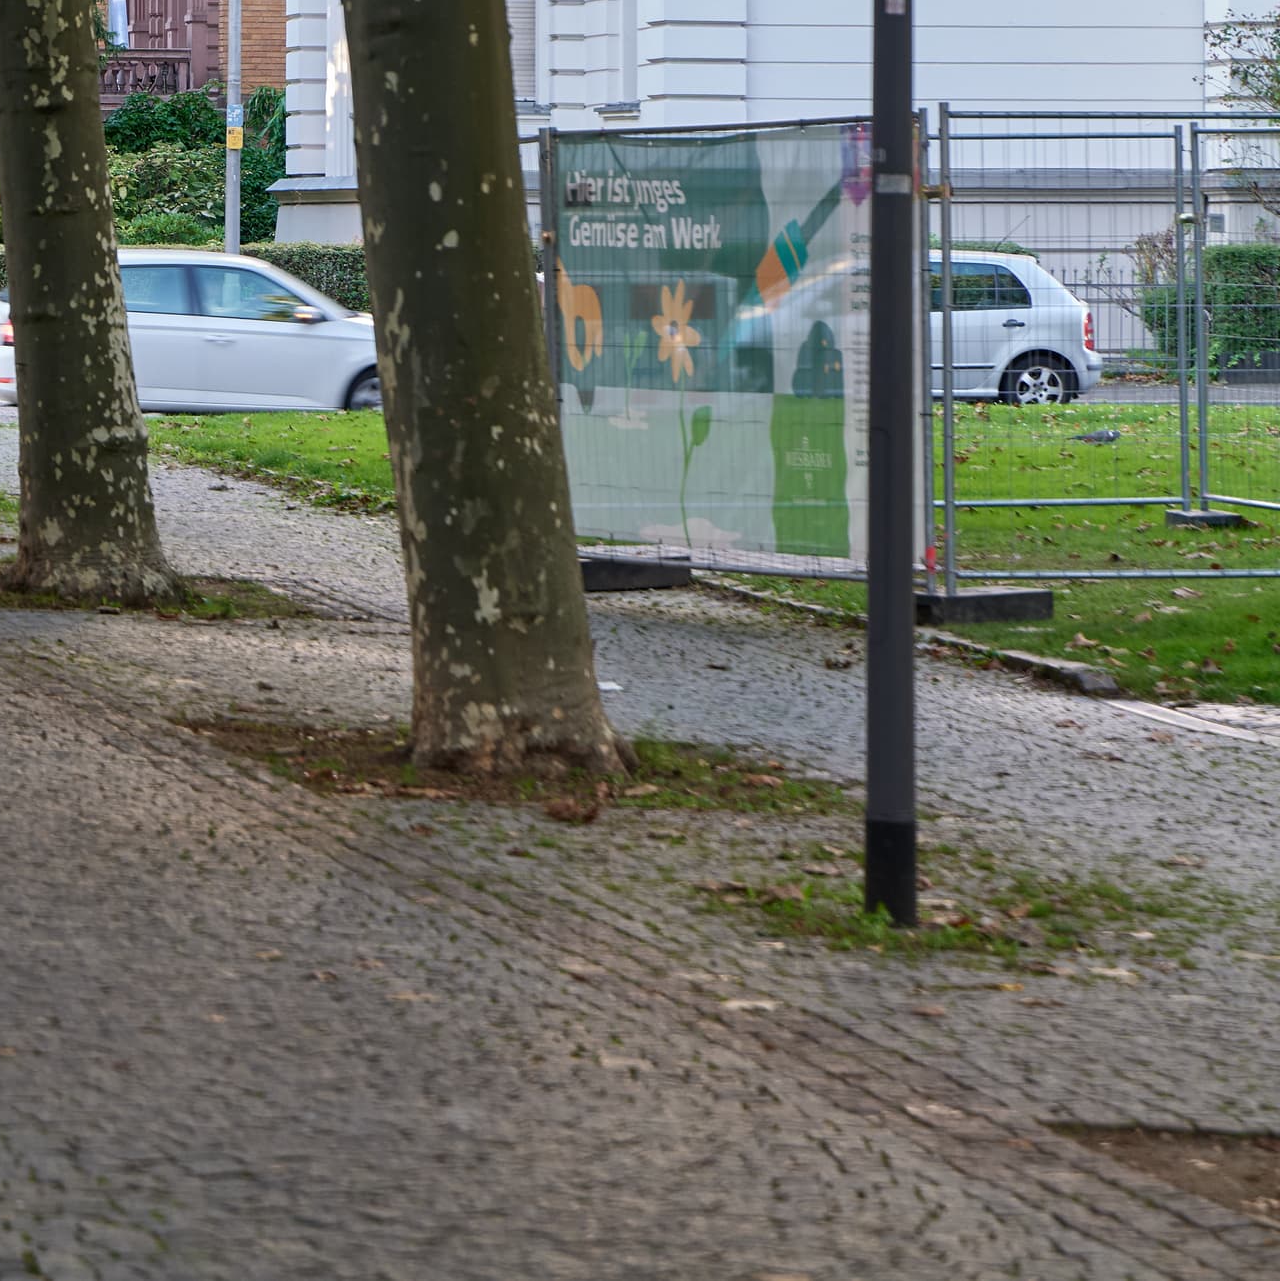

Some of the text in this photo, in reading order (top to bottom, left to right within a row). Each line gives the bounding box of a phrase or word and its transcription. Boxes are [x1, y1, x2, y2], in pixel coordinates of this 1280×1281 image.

[565, 170, 605, 203] Hier
[607, 170, 631, 203] ist
[569, 215, 640, 248] Gemüse
[643, 222, 667, 249] am
